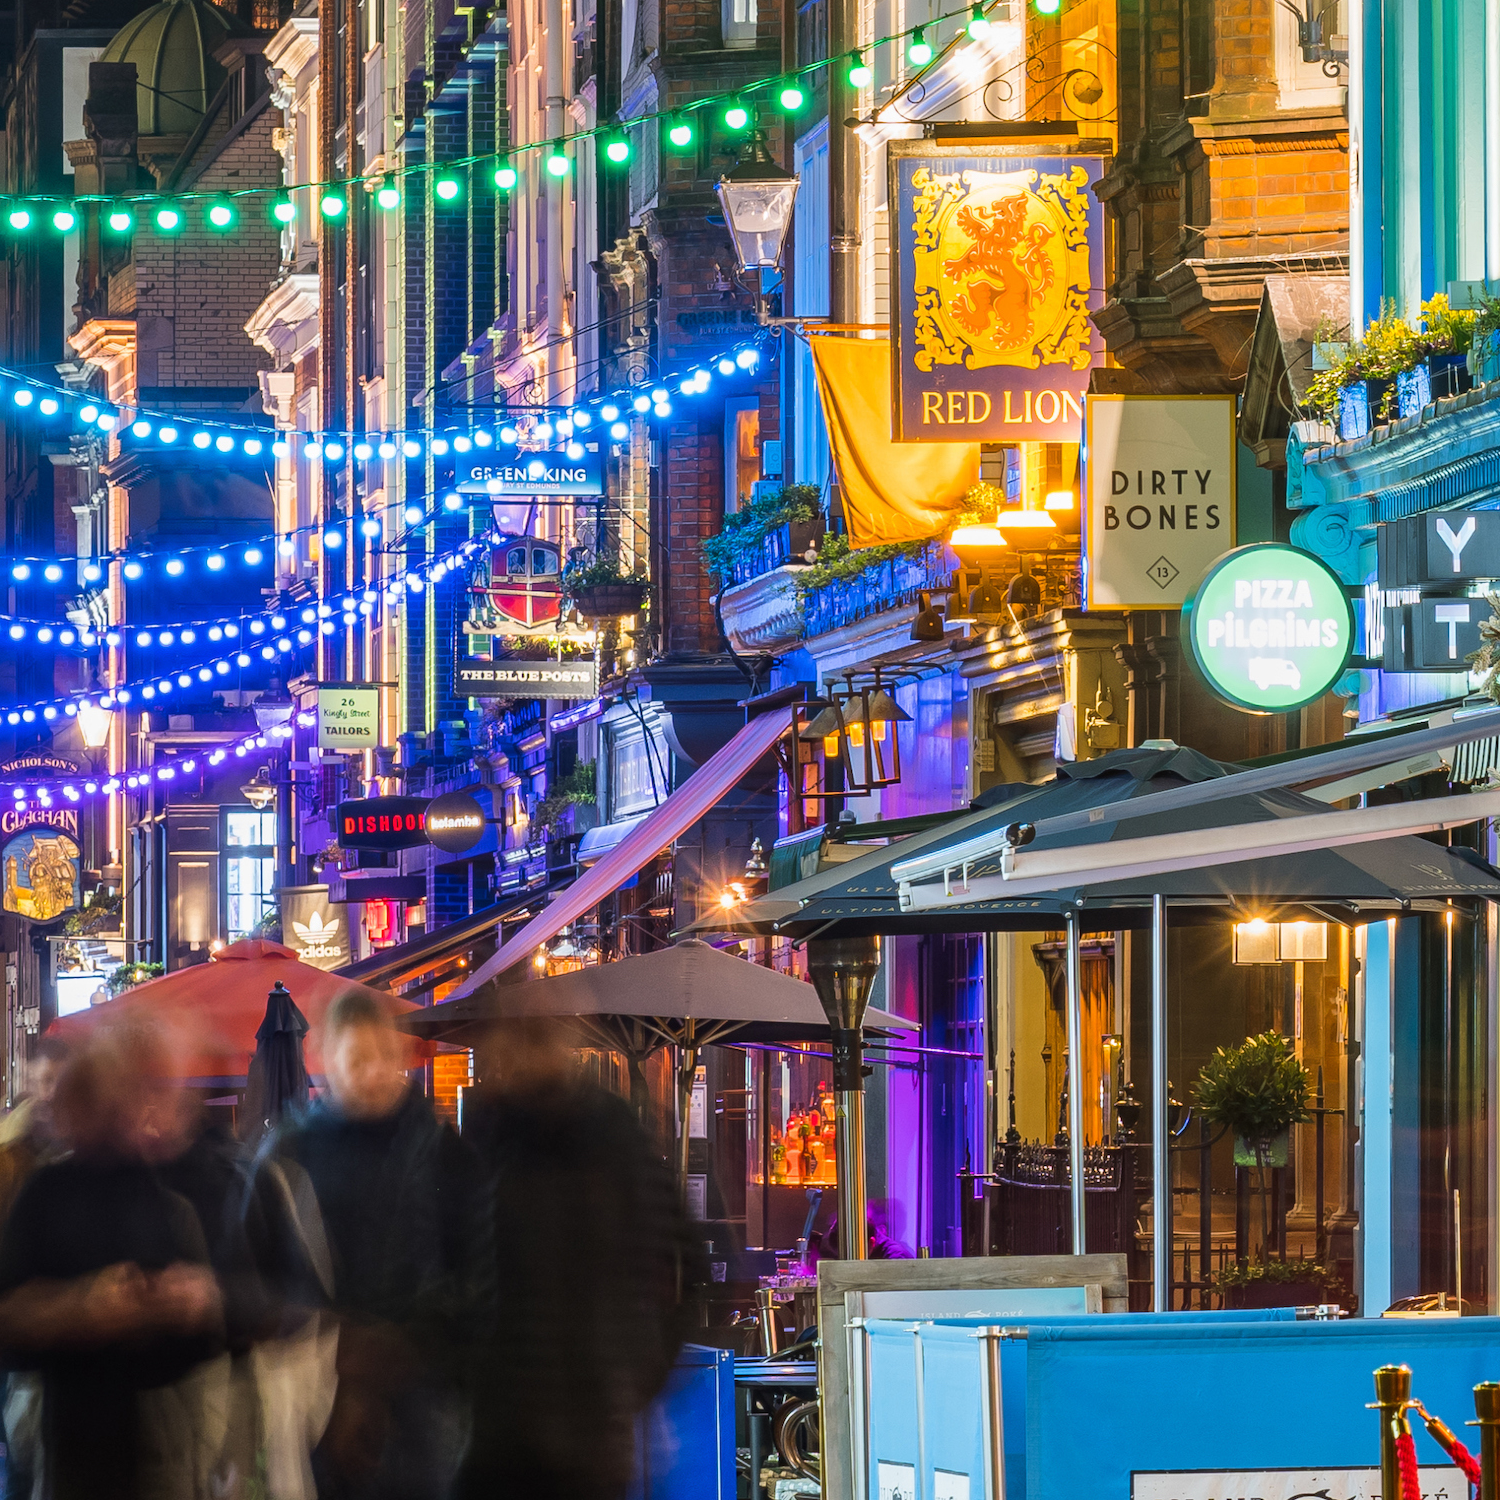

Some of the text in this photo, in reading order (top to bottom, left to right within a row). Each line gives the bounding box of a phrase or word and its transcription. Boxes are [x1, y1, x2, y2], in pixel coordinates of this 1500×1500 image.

[922, 390, 1083, 424] RED LION
[543, 468, 587, 483] KING
[1111, 469, 1212, 496] DIRTY
[1104, 505, 1220, 530] BONES
[1156, 568, 1169, 578] 13
[1234, 579, 1314, 609] PIZZA
[460, 670, 591, 684] THE BLUE POSTS
[341, 698, 355, 707] 26
[325, 726, 371, 737] TAILORS
[1, 756, 79, 775] NICHOLSON'S
[1, 809, 79, 838] CLACHAN
[431, 816, 480, 830] kolamba
